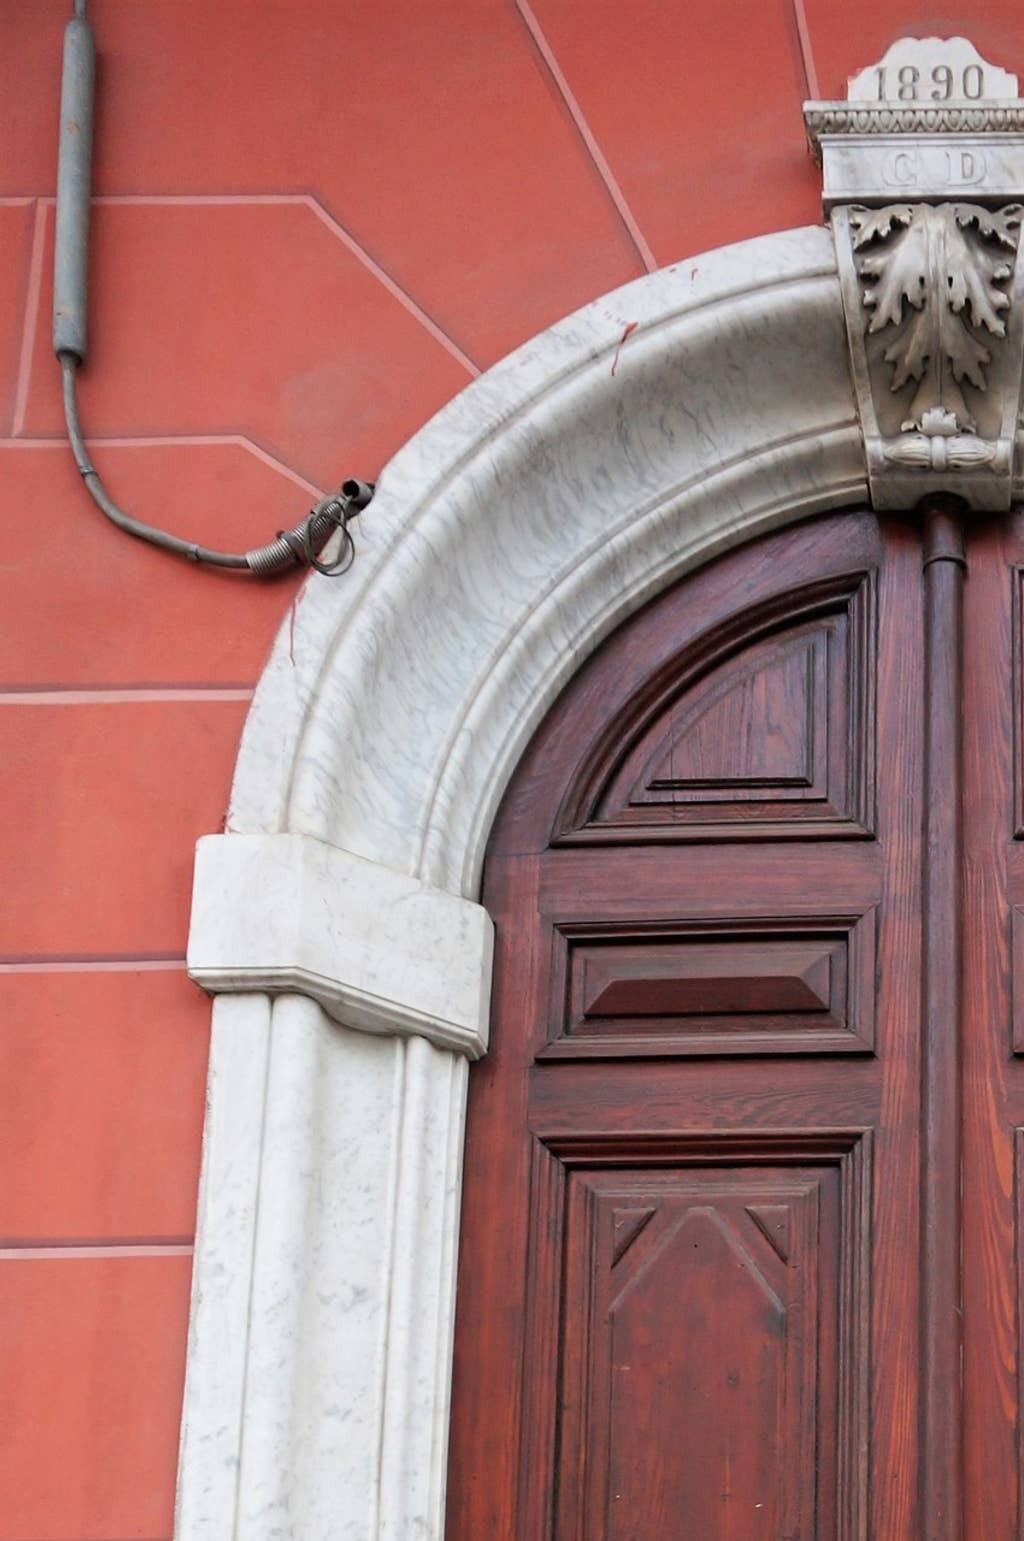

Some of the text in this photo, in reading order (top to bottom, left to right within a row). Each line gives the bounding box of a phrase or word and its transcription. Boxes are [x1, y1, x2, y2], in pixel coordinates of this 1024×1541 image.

[875, 64, 984, 101] 1890
[881, 152, 988, 187] C D
